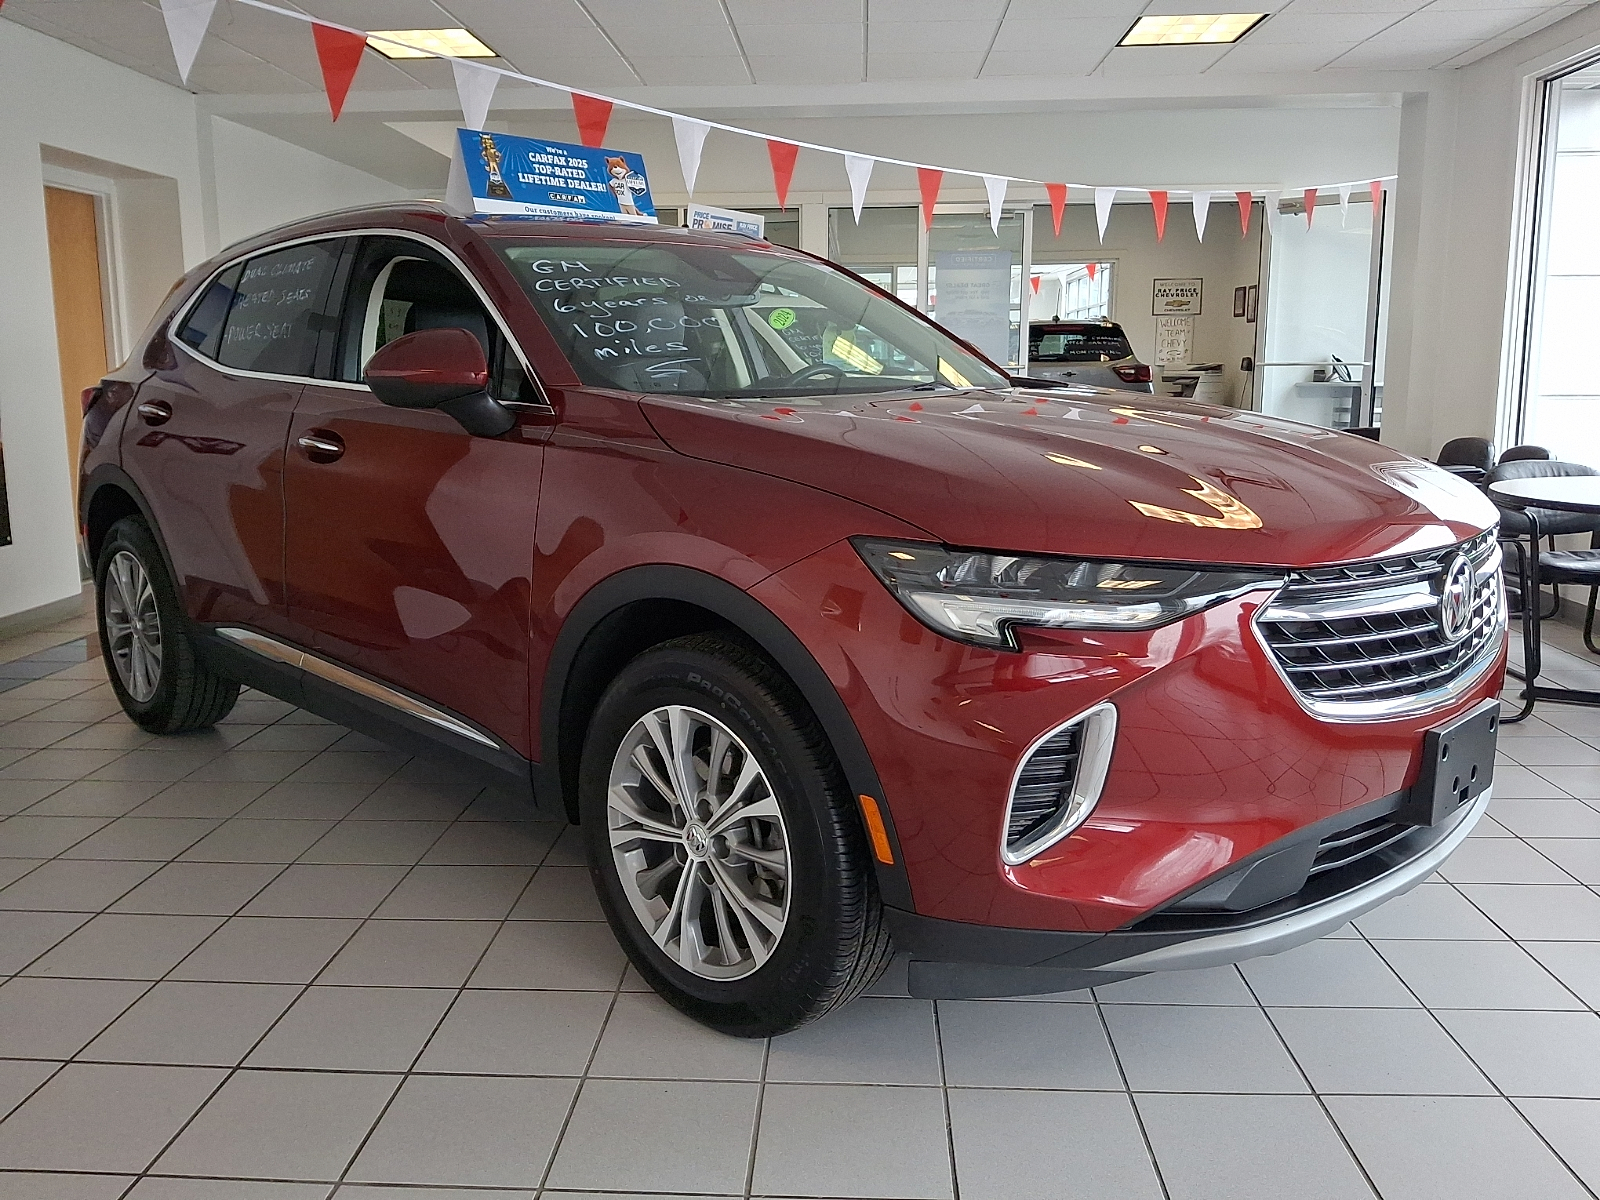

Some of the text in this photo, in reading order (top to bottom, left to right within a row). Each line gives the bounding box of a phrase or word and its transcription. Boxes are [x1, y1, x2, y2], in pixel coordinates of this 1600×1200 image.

[545, 146, 563, 155] We're
[528, 152, 589, 169] CARFAX 2025
[532, 163, 586, 179] TOP-RATED
[517, 172, 607, 192] LIFETIME DEALER!
[548, 191, 586, 203] CARFAX
[538, 208, 573, 217] customers
[693, 210, 710, 220] PRICE
[532, 259, 592, 274] GM
[535, 276, 681, 292] CERTIFIED
[773, 309, 792, 326] 2024
[1159, 317, 1191, 328] WELCOME
[1165, 329, 1187, 338] TEAM
[1160, 338, 1188, 348] CHEVY
